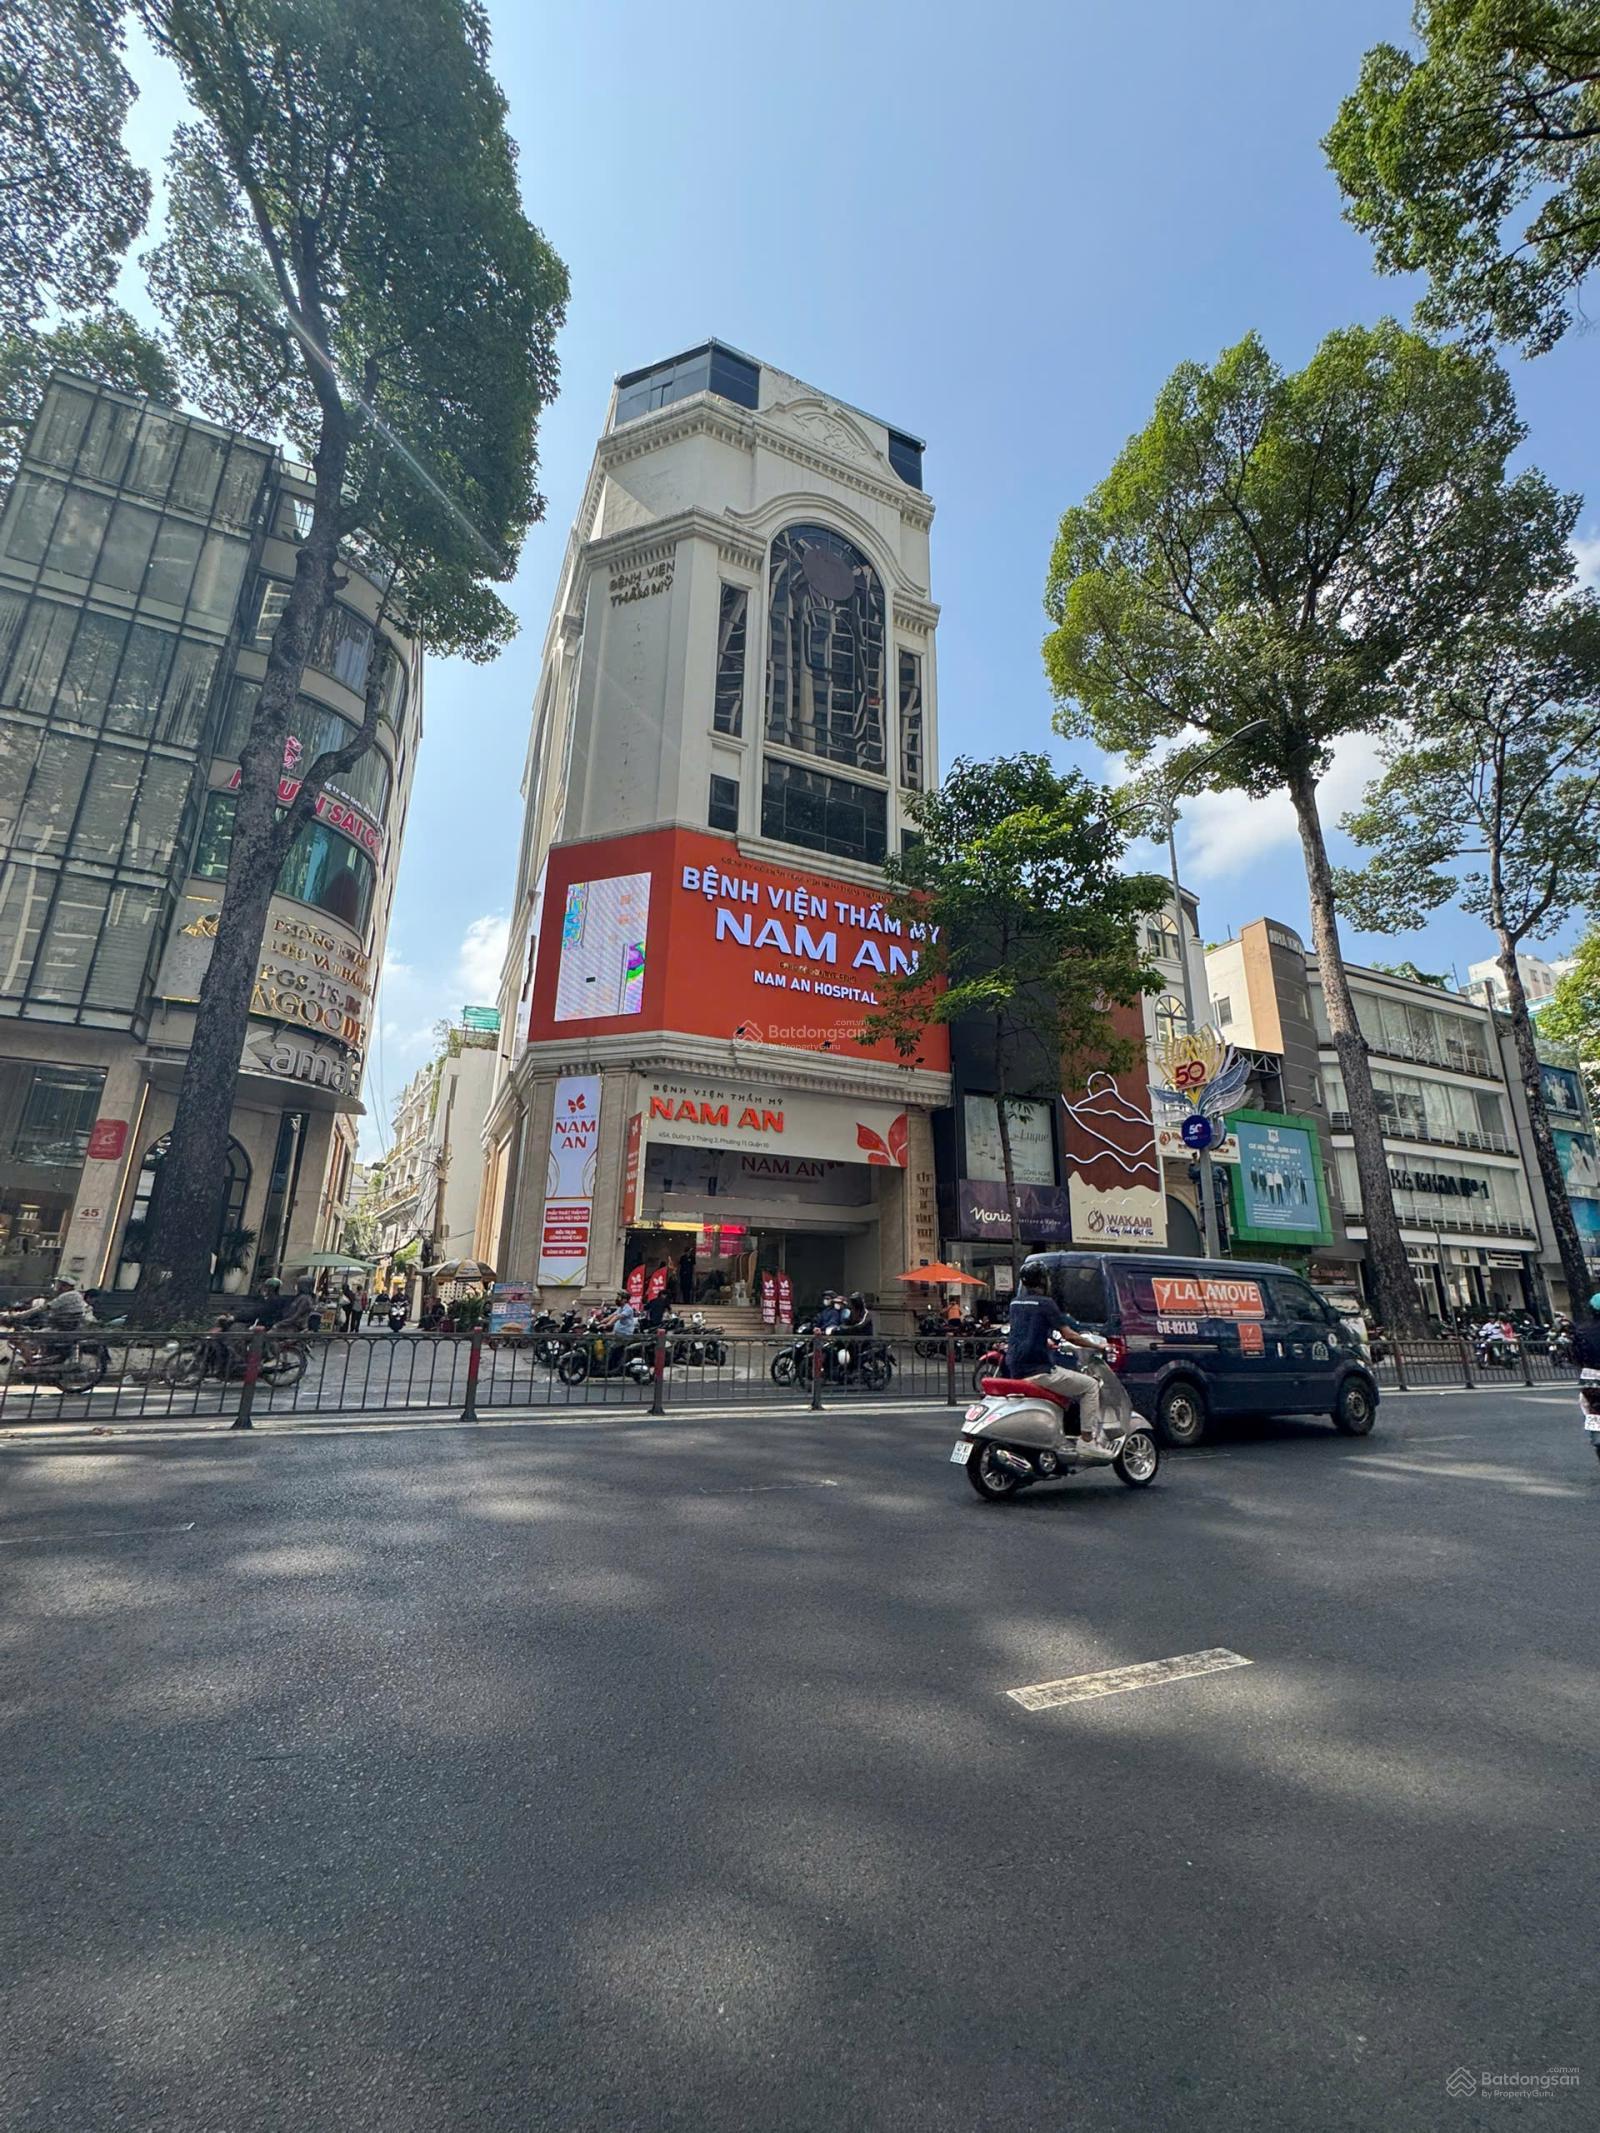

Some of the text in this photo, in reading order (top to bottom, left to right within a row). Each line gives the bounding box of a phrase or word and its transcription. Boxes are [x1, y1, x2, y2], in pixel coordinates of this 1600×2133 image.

[682, 864, 760, 905] BỆNH
[767, 886, 828, 921] VIỆN
[834, 900, 902, 937] THẨM
[715, 906, 838, 965] NAM
[852, 938, 920, 977] AN
[754, 969, 787, 989] NAM
[790, 975, 811, 993] AN
[814, 981, 879, 1006] HOSPITAL
[1176, 1060, 1205, 1086] 50
[653, 1083, 783, 1106] BỆNH VIỆN THẨM MỸ
[649, 1095, 785, 1133] NAM AN
[555, 1120, 596, 1134] NAM
[561, 1135, 587, 1149] AN
[741, 1156, 824, 1177] NAM AN
[82, 1208, 99, 1218] 45
[1106, 1214, 1153, 1228] WAKAMI
[1174, 1282, 1259, 1303] LALAMOVE
